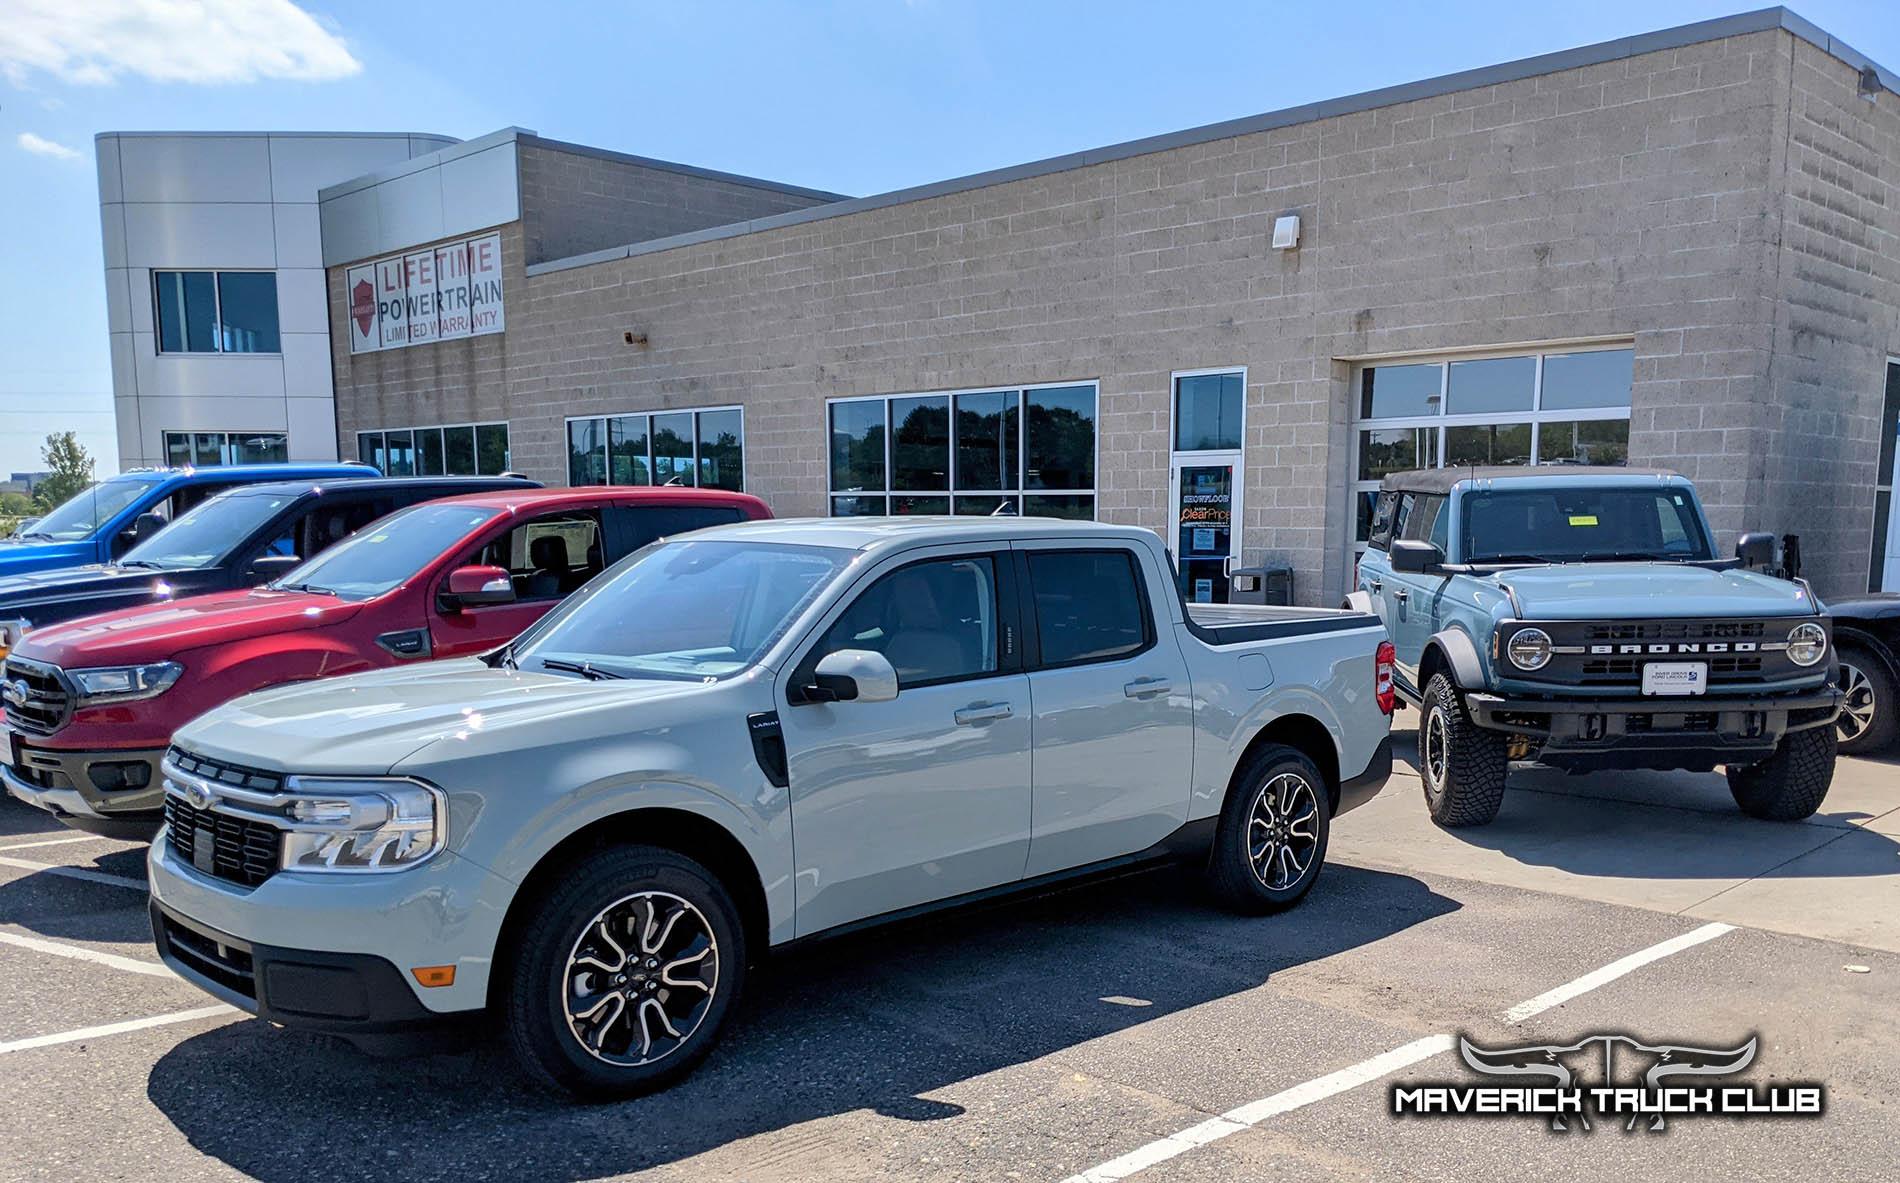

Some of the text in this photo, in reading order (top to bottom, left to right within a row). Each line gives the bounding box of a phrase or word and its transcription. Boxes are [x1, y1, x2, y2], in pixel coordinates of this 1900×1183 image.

[384, 242, 492, 292] LIFETIME
[381, 280, 502, 322] POWERTRAIN
[1591, 642, 1756, 654] BRONCO
[753, 720, 779, 728] LARIAT
